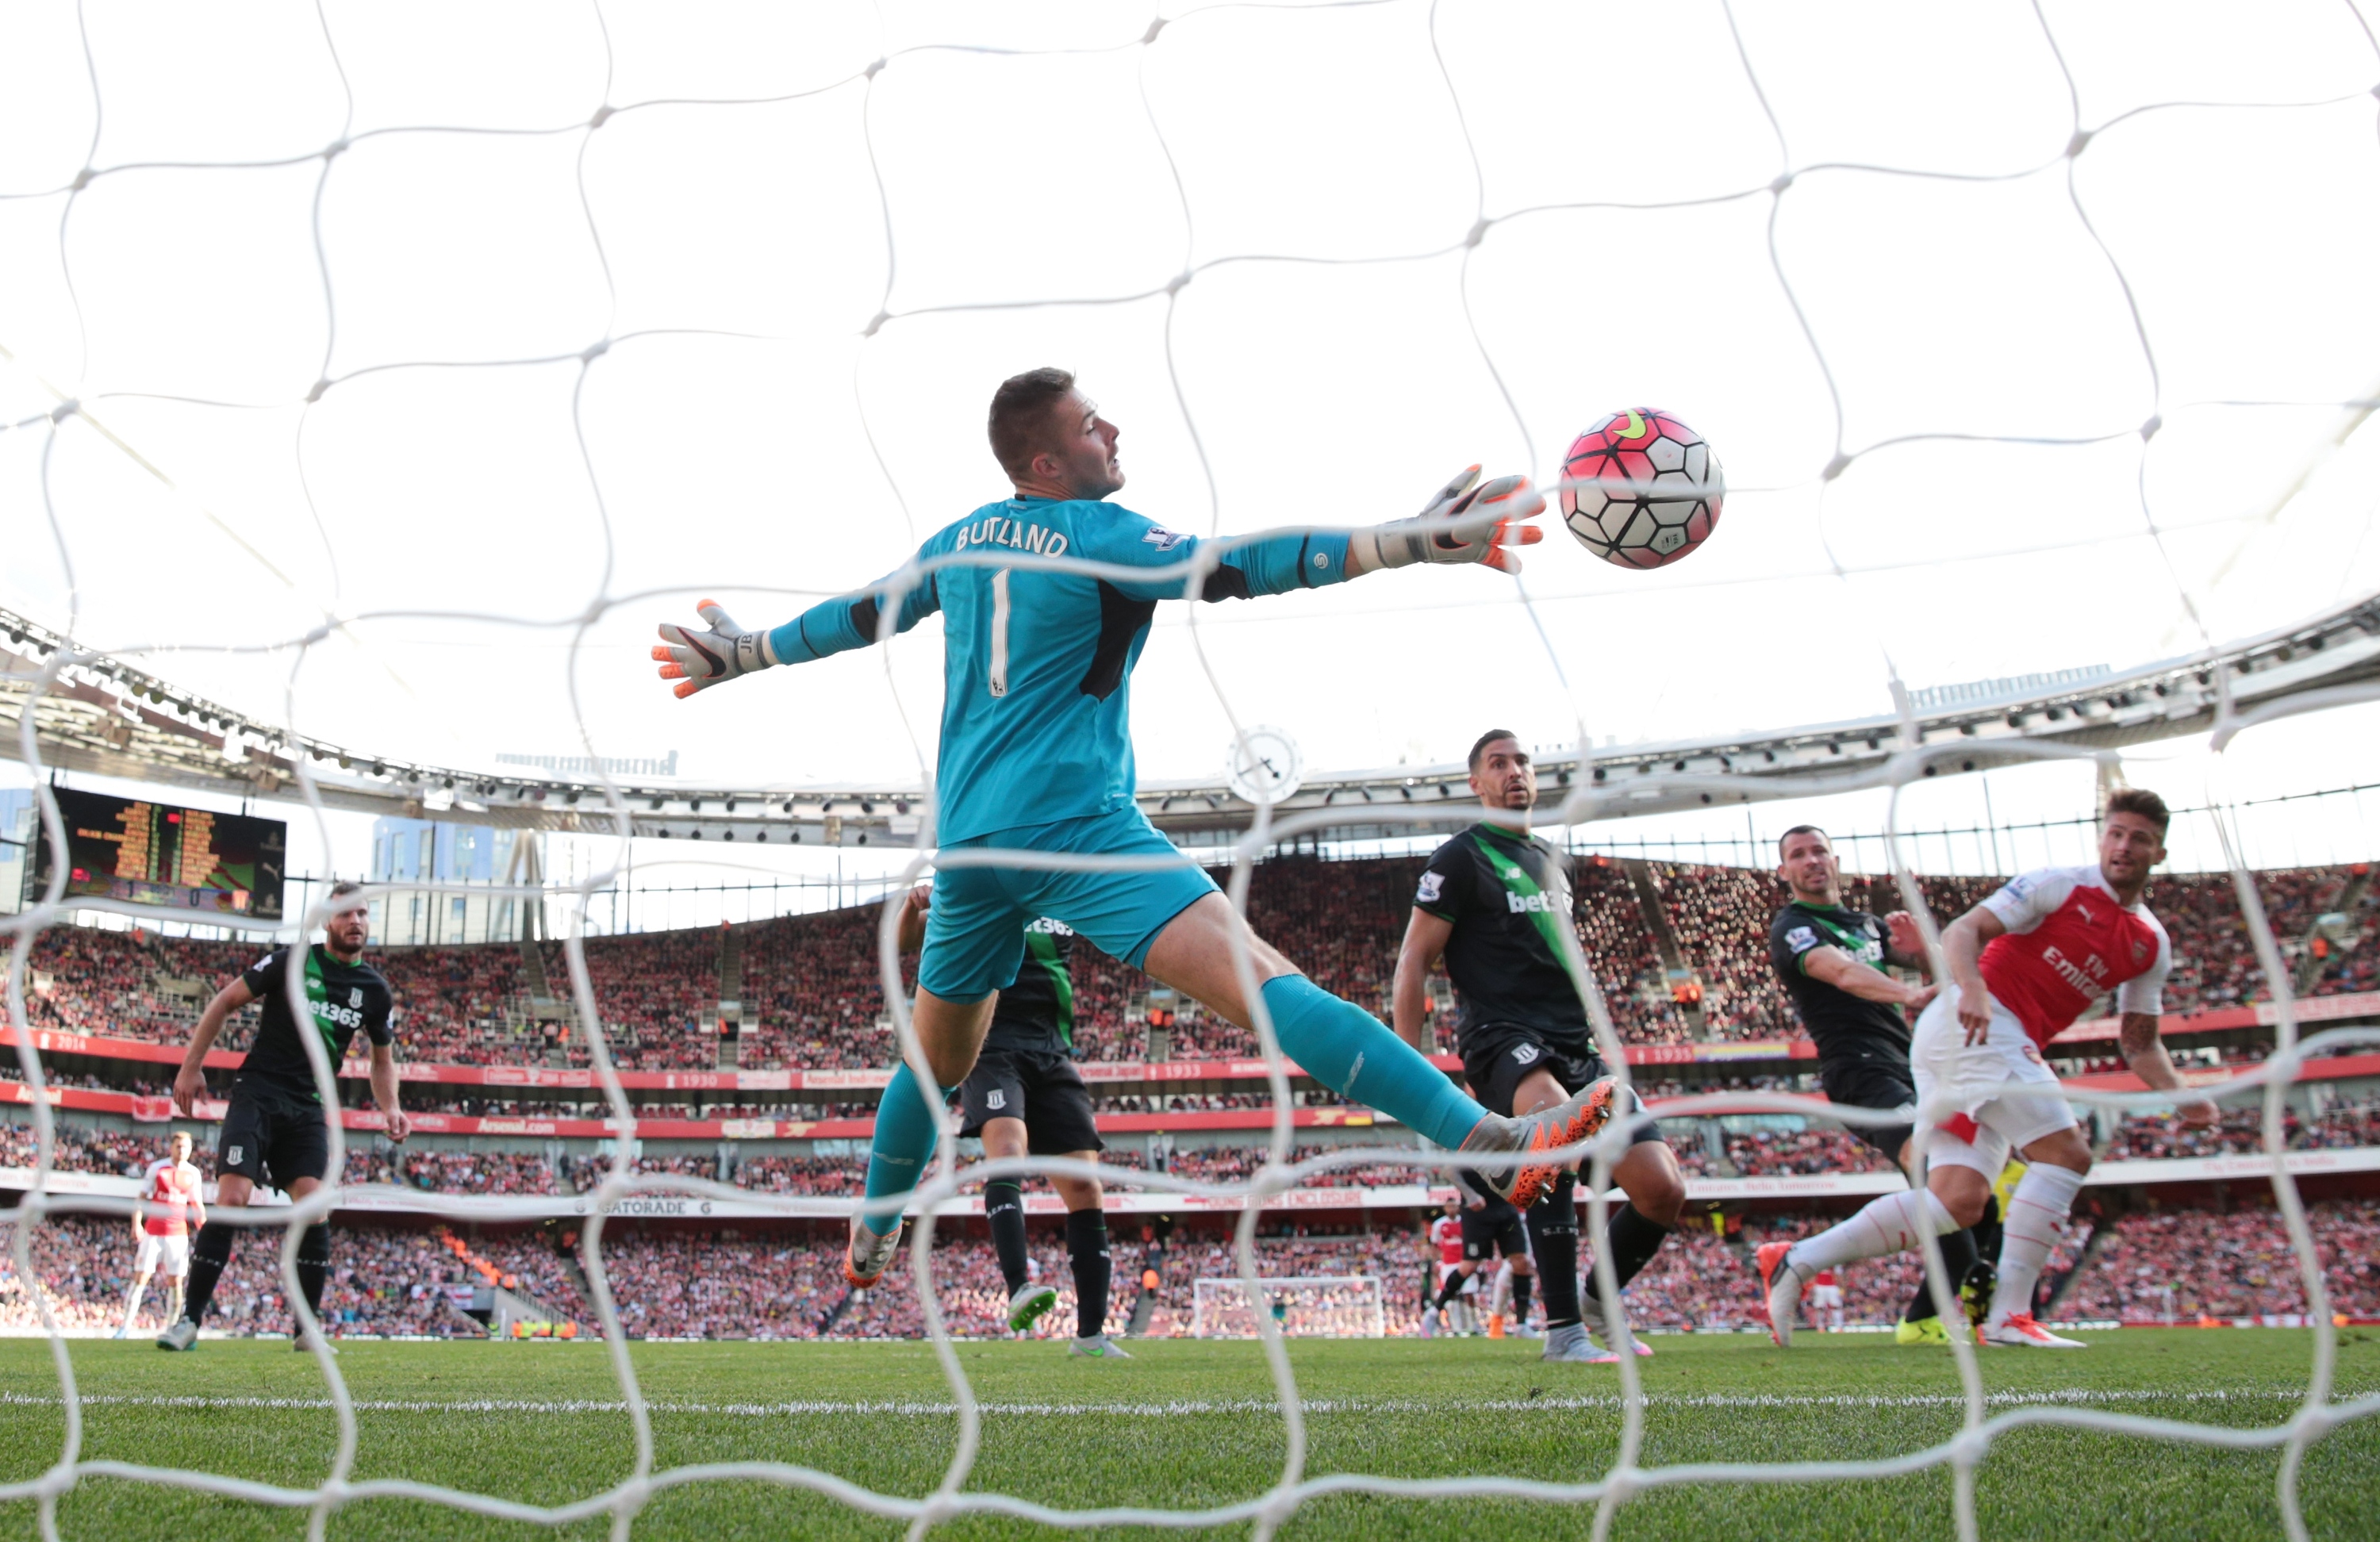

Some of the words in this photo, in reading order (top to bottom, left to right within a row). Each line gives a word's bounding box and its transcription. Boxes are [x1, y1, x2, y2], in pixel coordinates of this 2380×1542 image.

[956, 516, 1069, 558] BUTLAND
[988, 566, 1012, 698] 1
[739, 635, 753, 654] JB
[1024, 916, 1074, 937] t365
[2042, 946, 2104, 1000] Emira
[2084, 953, 2109, 980] Fly
[57, 1034, 86, 1051] 2014
[682, 1074, 718, 1087] 1930
[1165, 1064, 1201, 1078] 1933
[477, 1118, 555, 1134] Arsenal.com
[601, 1202, 686, 1214] GATORADE
